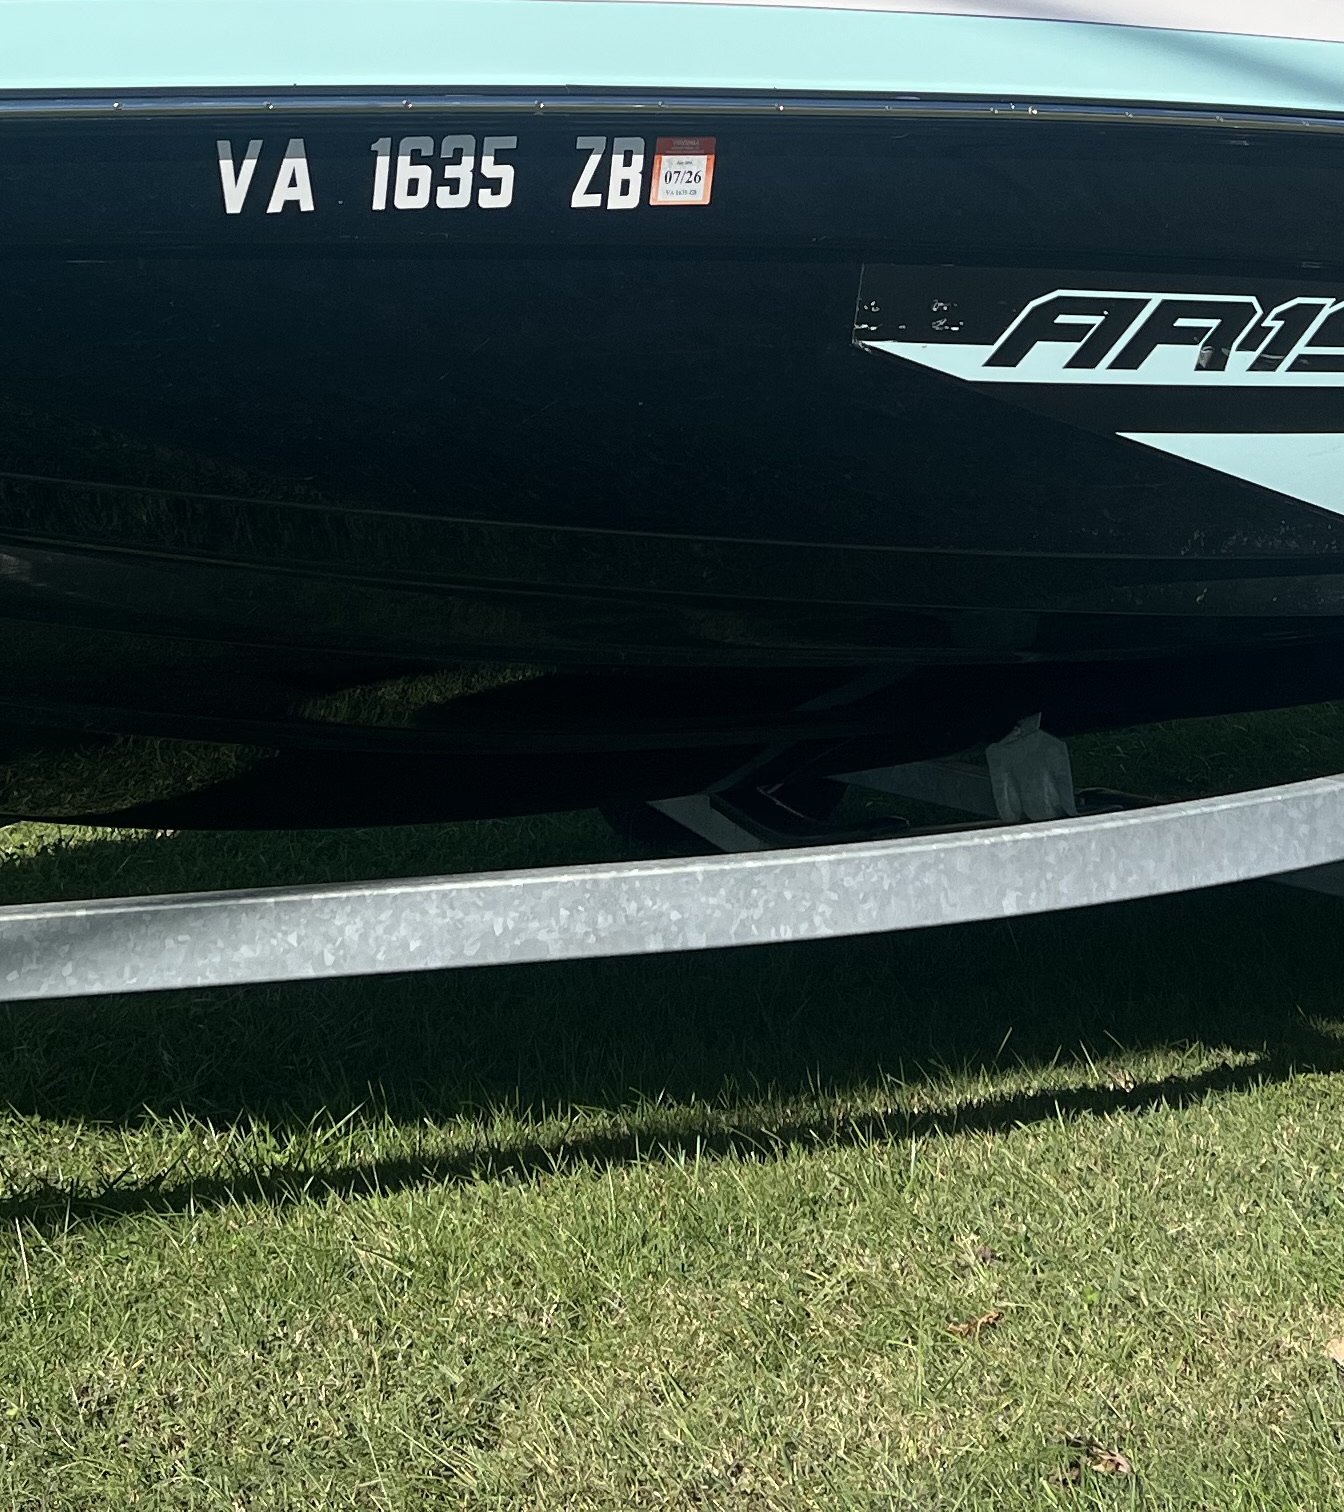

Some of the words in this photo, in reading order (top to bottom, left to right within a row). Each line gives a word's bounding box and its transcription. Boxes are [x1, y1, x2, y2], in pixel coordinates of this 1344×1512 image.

[216, 139, 315, 214] VA
[370, 135, 518, 211] 1635
[571, 136, 645, 210] ZB
[664, 170, 702, 185] 07/26
